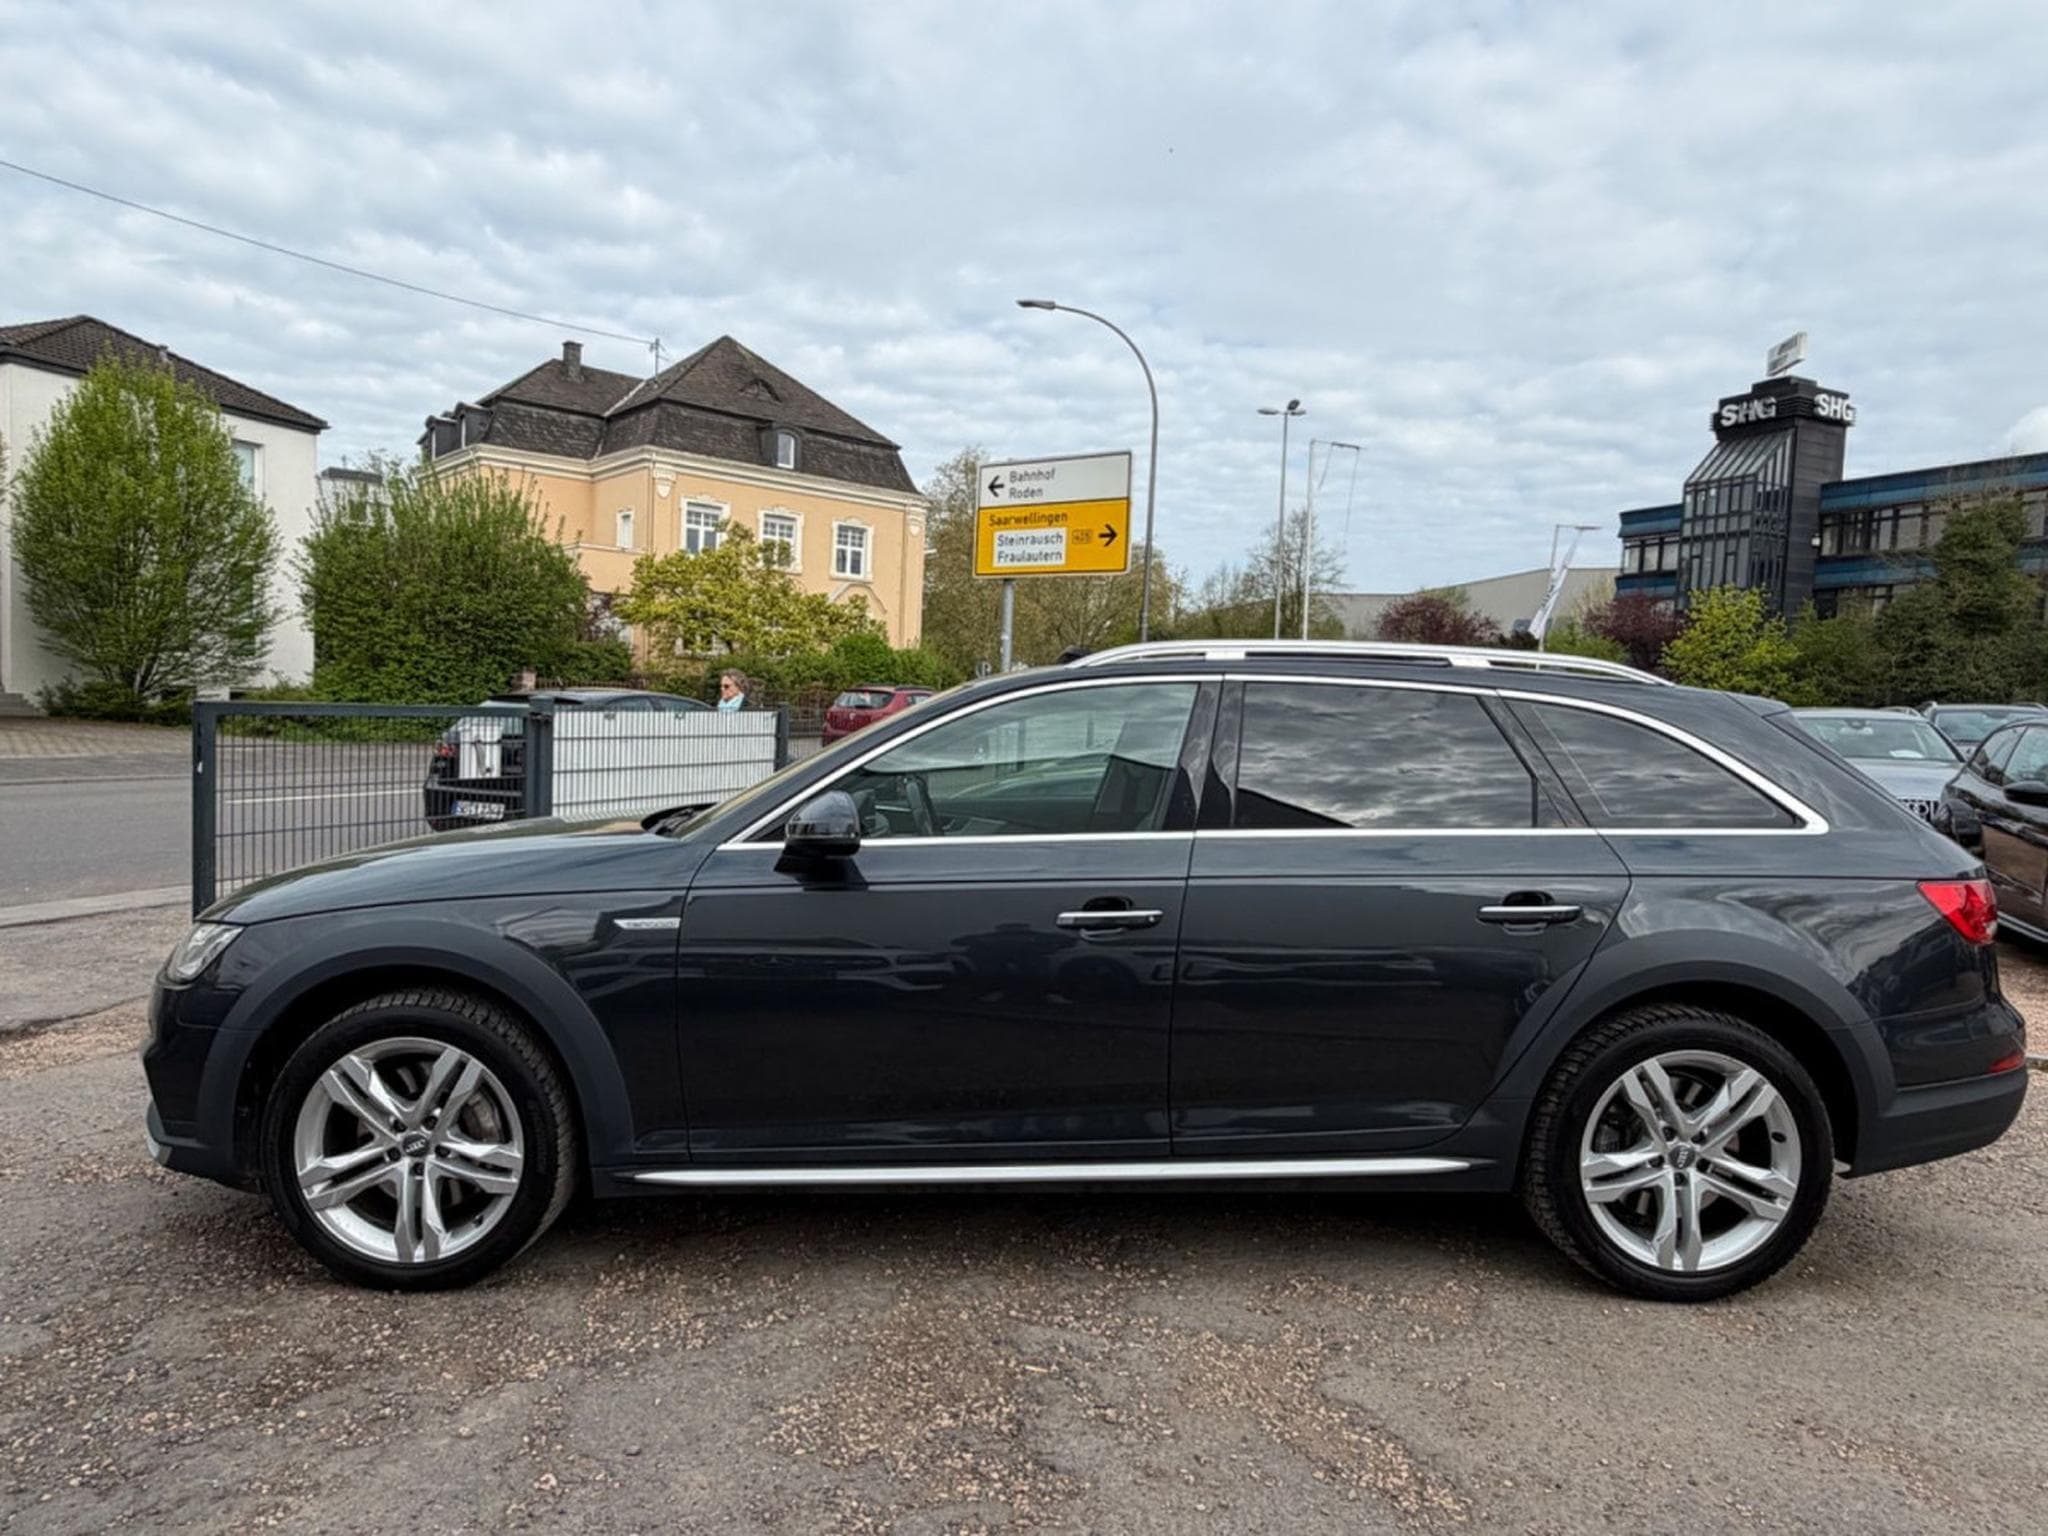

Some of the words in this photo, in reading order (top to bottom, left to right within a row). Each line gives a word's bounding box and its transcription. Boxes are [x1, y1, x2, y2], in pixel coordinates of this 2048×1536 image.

[1720, 397, 1776, 427] SHG
[1815, 393, 1854, 421] SHG
[1009, 468, 1055, 482] Bahnhof
[1009, 487, 1043, 499] Roden
[989, 512, 1068, 526] Saarwellingen
[998, 532, 1063, 546] Steinrausch
[998, 550, 1063, 563] Fraulautern
